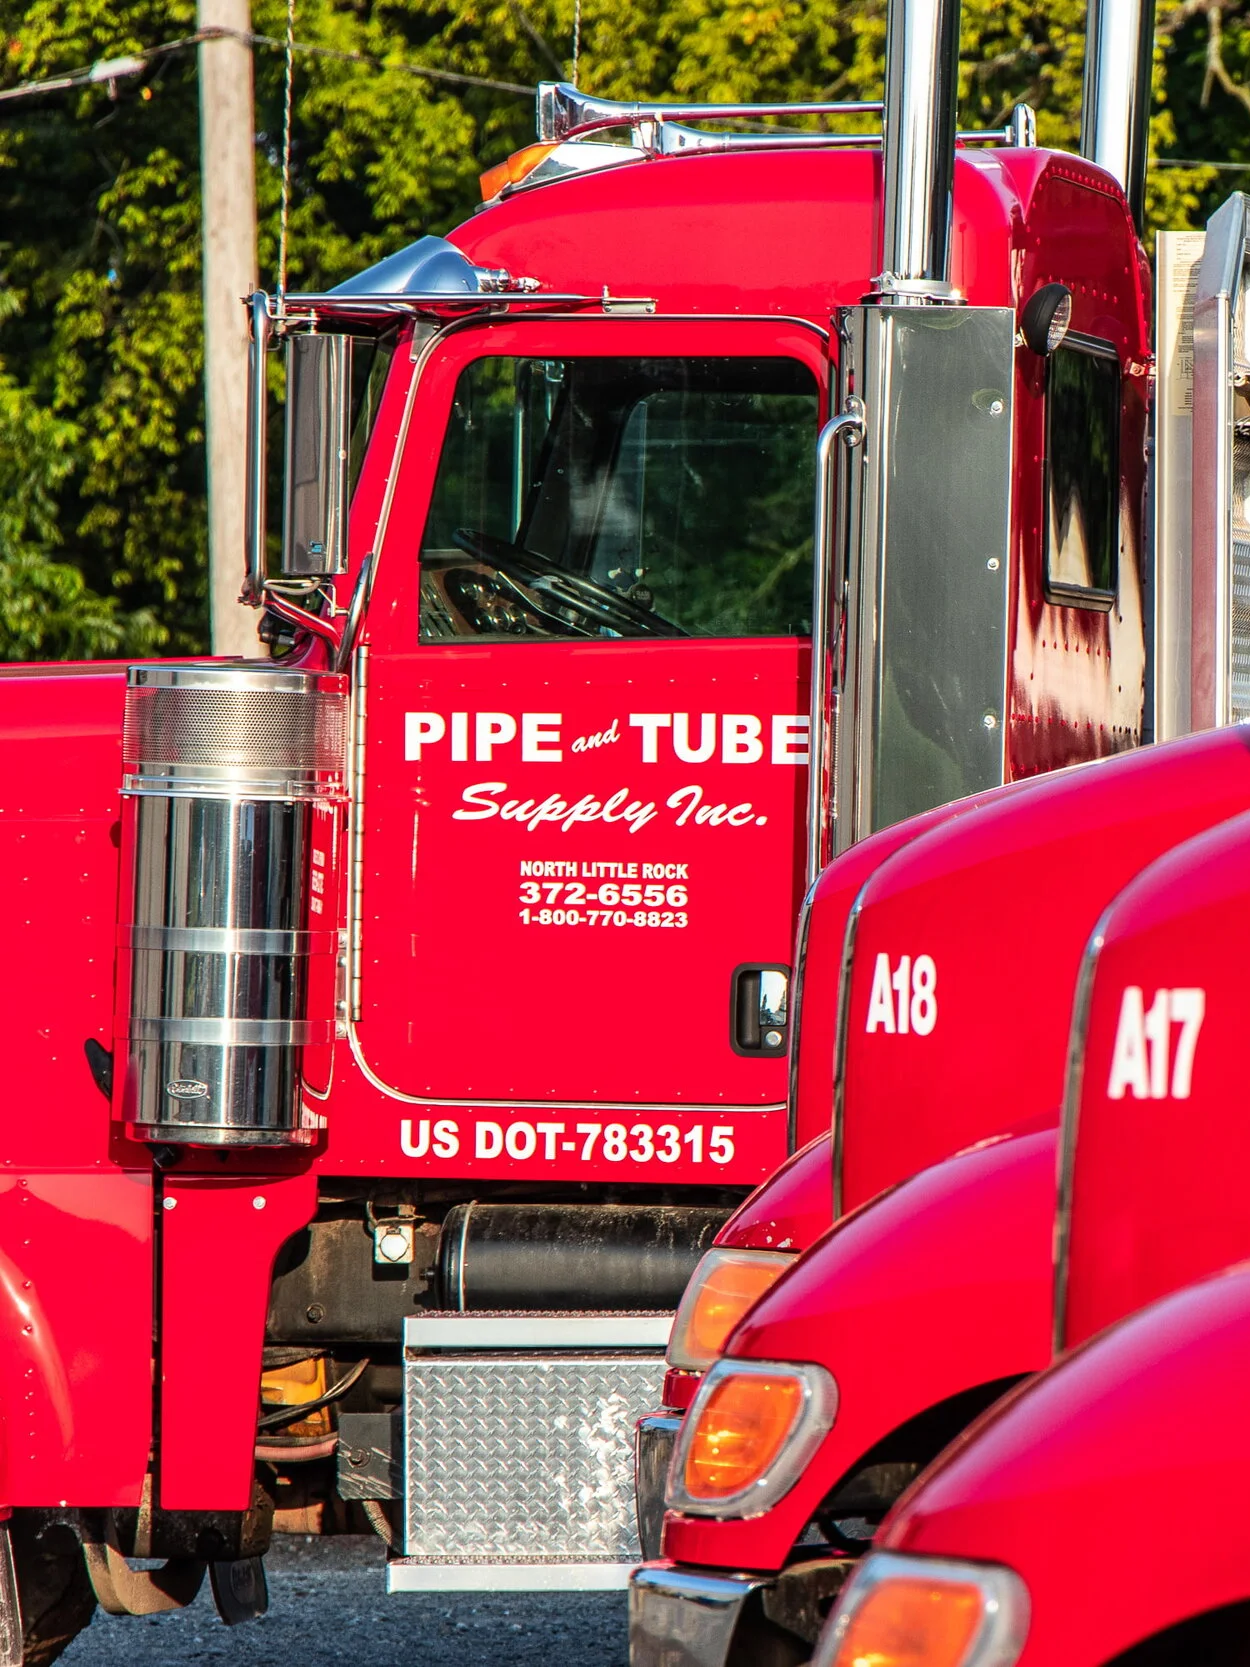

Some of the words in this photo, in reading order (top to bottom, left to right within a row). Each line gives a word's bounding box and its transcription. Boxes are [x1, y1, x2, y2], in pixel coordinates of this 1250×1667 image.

[404, 712, 563, 762] PIPE
[571, 718, 621, 753] and
[629, 713, 810, 765] TUBE
[452, 782, 658, 833] Supply
[665, 785, 769, 827] Inc.
[519, 860, 578, 877] NORTH
[581, 861, 638, 879] LITTLE
[642, 863, 689, 880] ROCK
[518, 881, 688, 907] 372-6556
[518, 908, 688, 928] 1-800-770-8823
[866, 953, 937, 1036] A18
[1107, 986, 1206, 1100] A17
[400, 1119, 460, 1159] US
[475, 1121, 735, 1163] DOT-783315
